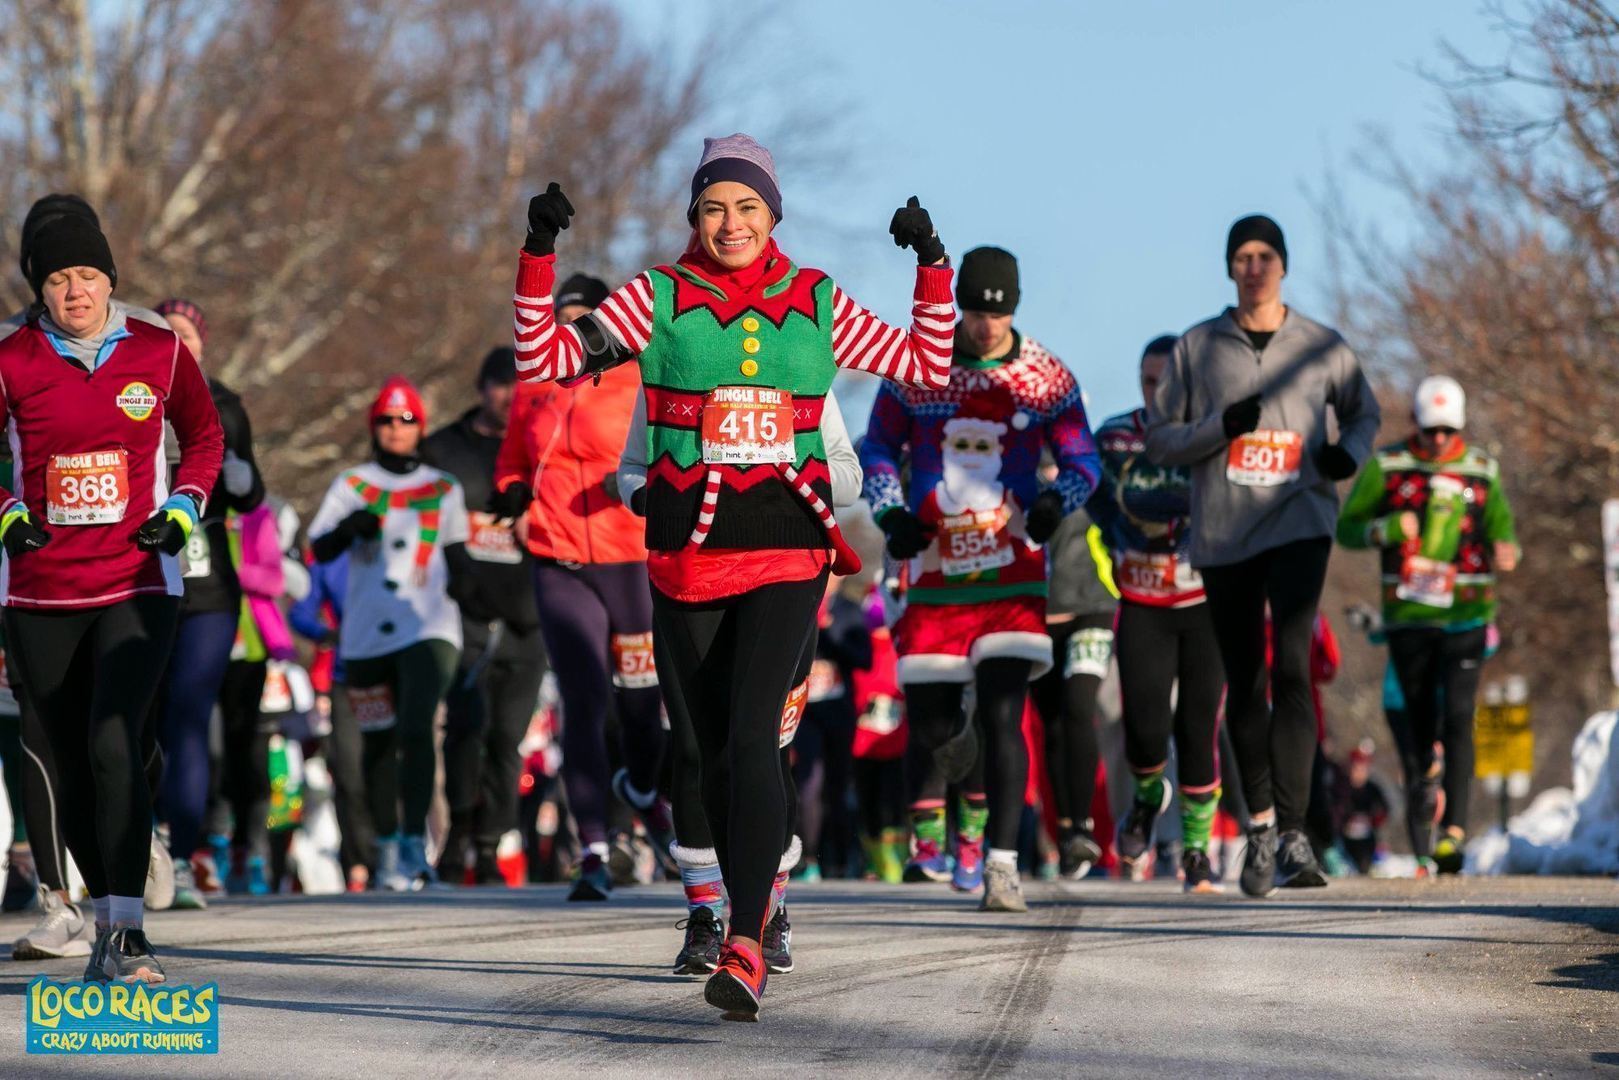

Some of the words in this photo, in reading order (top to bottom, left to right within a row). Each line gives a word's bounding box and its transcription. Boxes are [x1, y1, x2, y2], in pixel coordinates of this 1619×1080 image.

[713, 388, 754, 403] JINGLE
[758, 390, 782, 404] BELL
[718, 410, 778, 441] 415
[55, 454, 93, 469] JINGLE
[95, 452, 121, 467] BELL
[725, 451, 741, 459] hint
[1241, 445, 1286, 471] 501
[60, 473, 119, 504] 368
[950, 527, 998, 558] 554
[1129, 566, 1167, 589] 107
